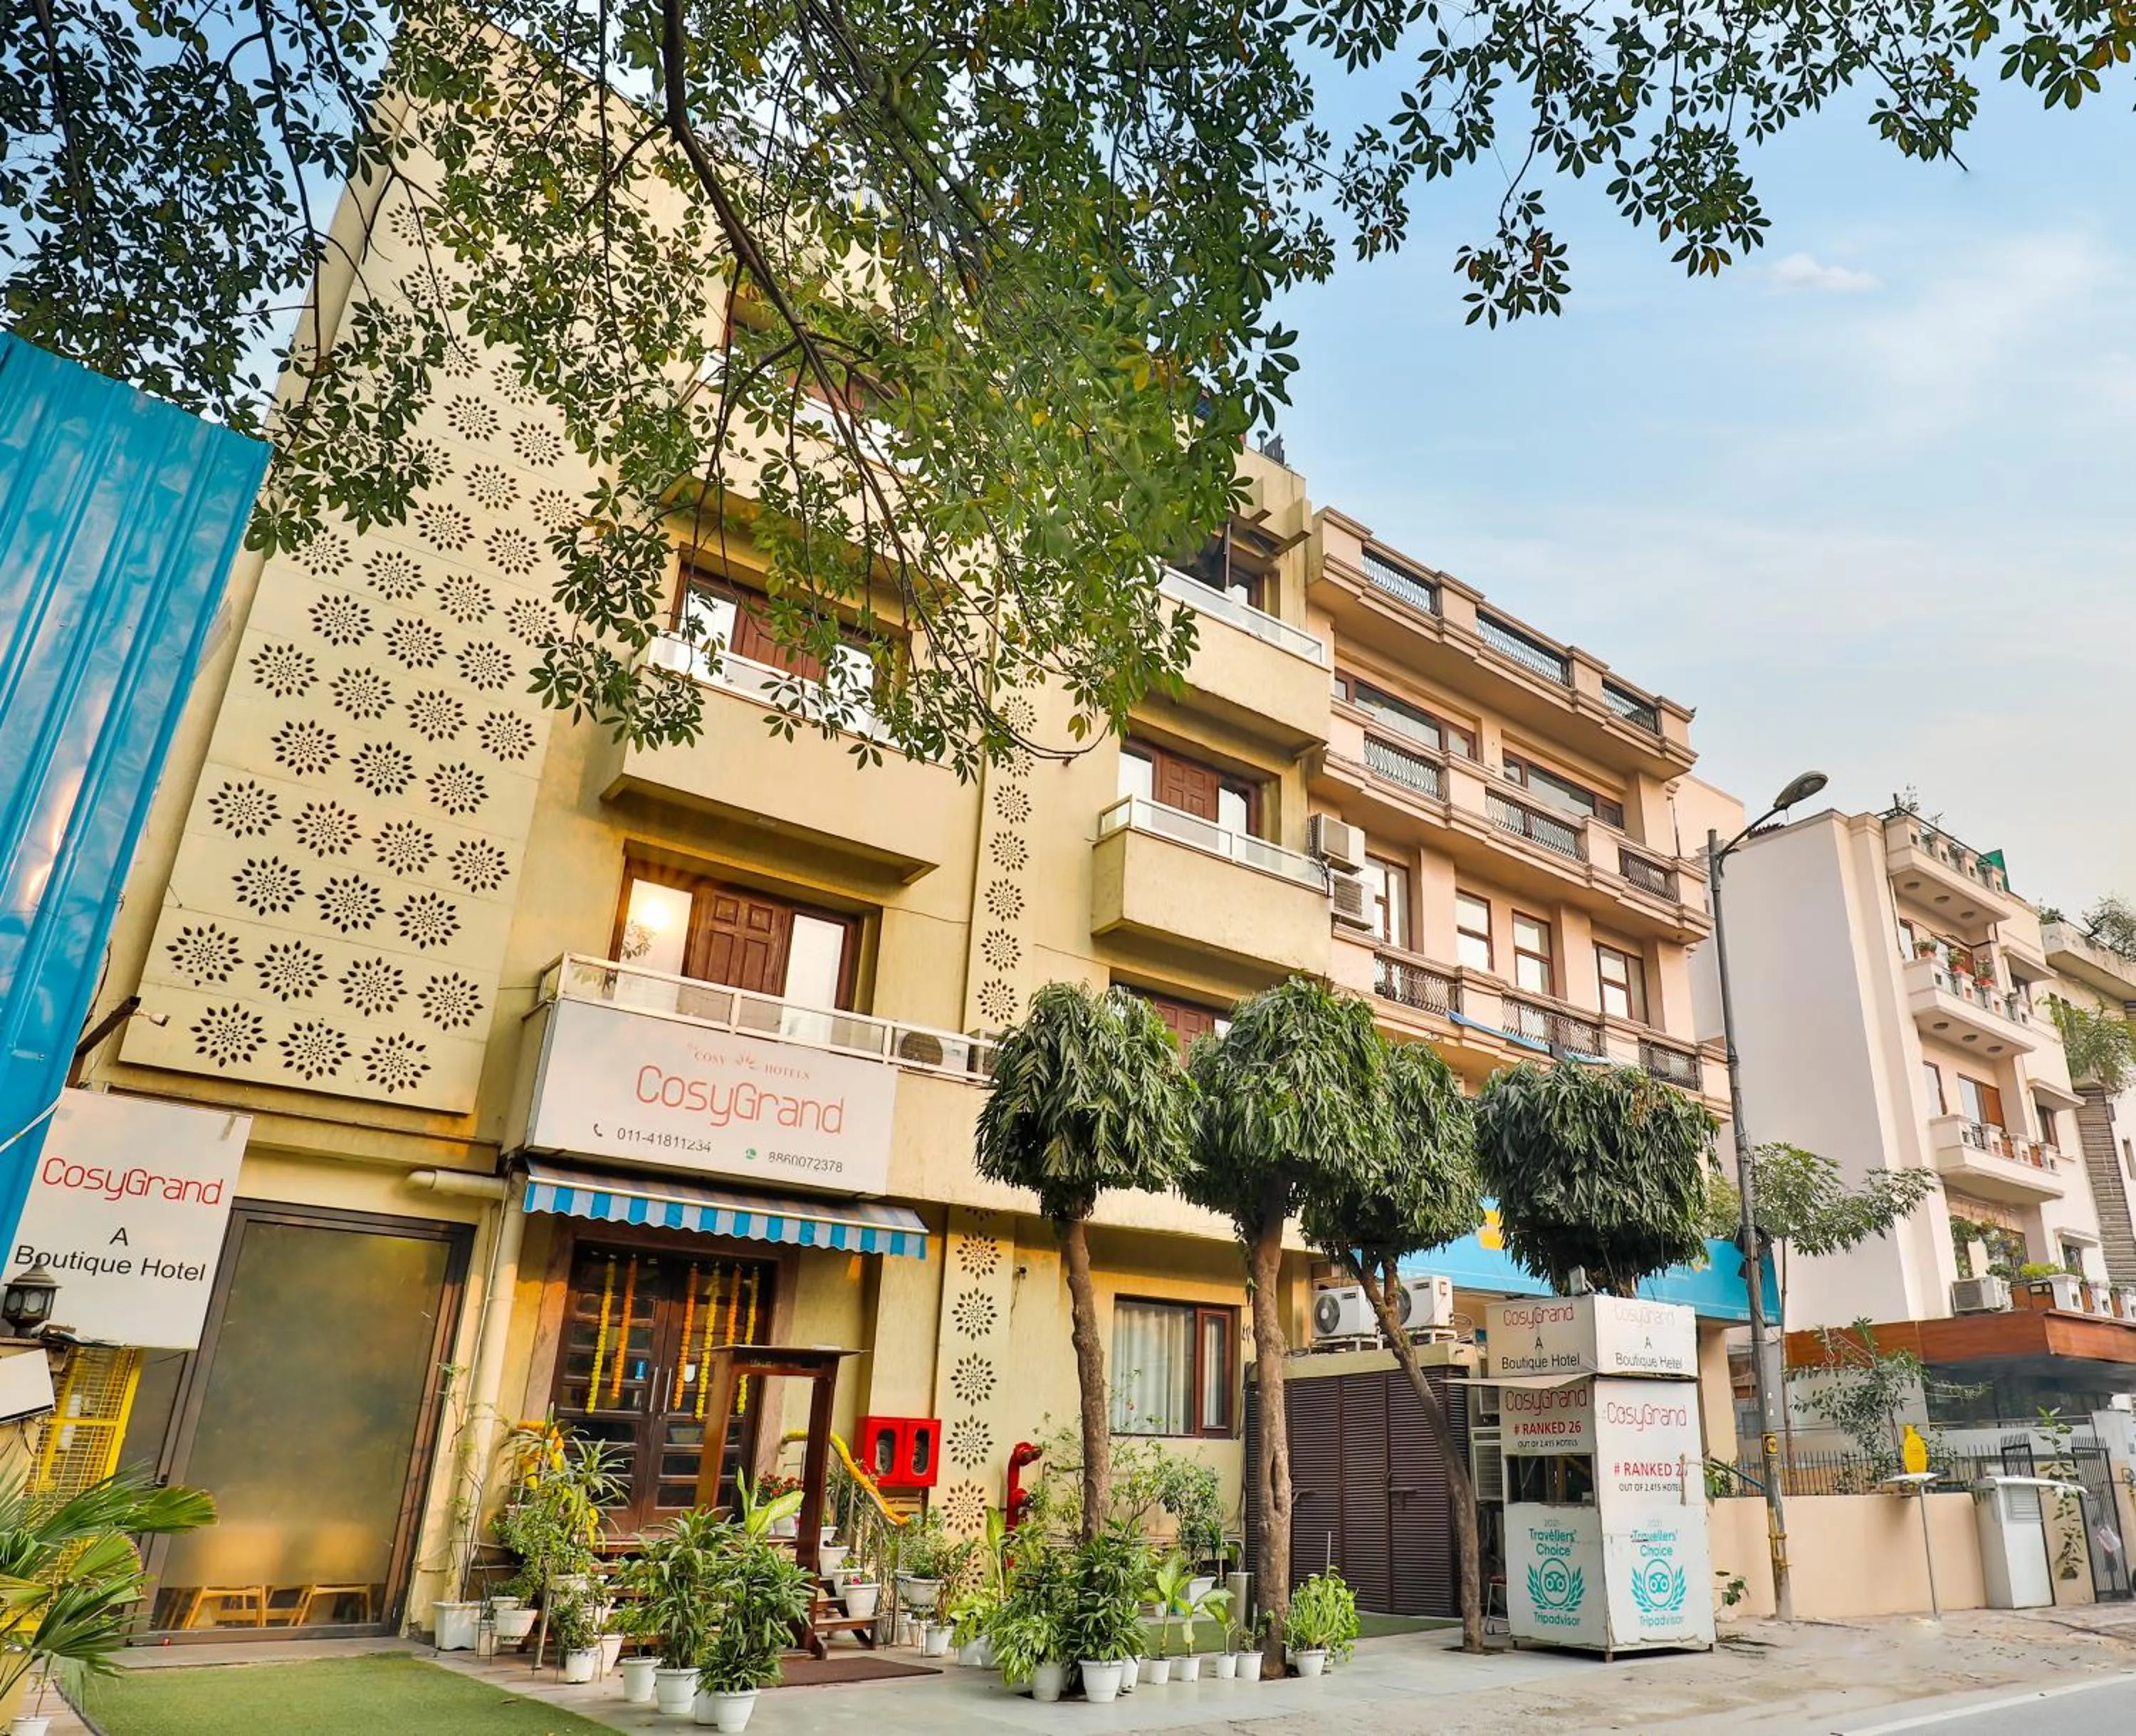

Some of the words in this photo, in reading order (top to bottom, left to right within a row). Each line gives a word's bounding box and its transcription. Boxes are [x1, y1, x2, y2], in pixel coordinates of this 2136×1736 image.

[637, 1065, 844, 1134] CosyGrand
[617, 1127, 711, 1153] 011-41811234
[42, 1157, 224, 1206] CosyGrand
[109, 1227, 129, 1246] A
[14, 1245, 132, 1277] Boutique
[140, 1257, 206, 1282] Hotel
[1503, 1302, 1574, 1329] CosyGrand
[1534, 1337, 1544, 1350] A
[1644, 1336, 1653, 1349] A
[1502, 1356, 1549, 1371] Boutique
[1551, 1352, 1581, 1367] Hotel
[1615, 1352, 1658, 1369] Boutique
[1505, 1384, 1588, 1416] CosyGrand
[1607, 1401, 1687, 1432] CosyGrand
[1523, 1421, 1566, 1436] RANKED
[1569, 1421, 1582, 1434] 26
[1613, 1462, 1621, 1477] #
[1623, 1461, 1673, 1477] RANKED
[1618, 1483, 1633, 1492] OUT
[1634, 1483, 1645, 1492] OF
[1536, 1542, 1572, 1557] Choice
[1640, 1544, 1674, 1557] Choice
[1534, 1611, 1581, 1627] Tripadvisor
[1638, 1615, 1685, 1628] Tripadvisor
